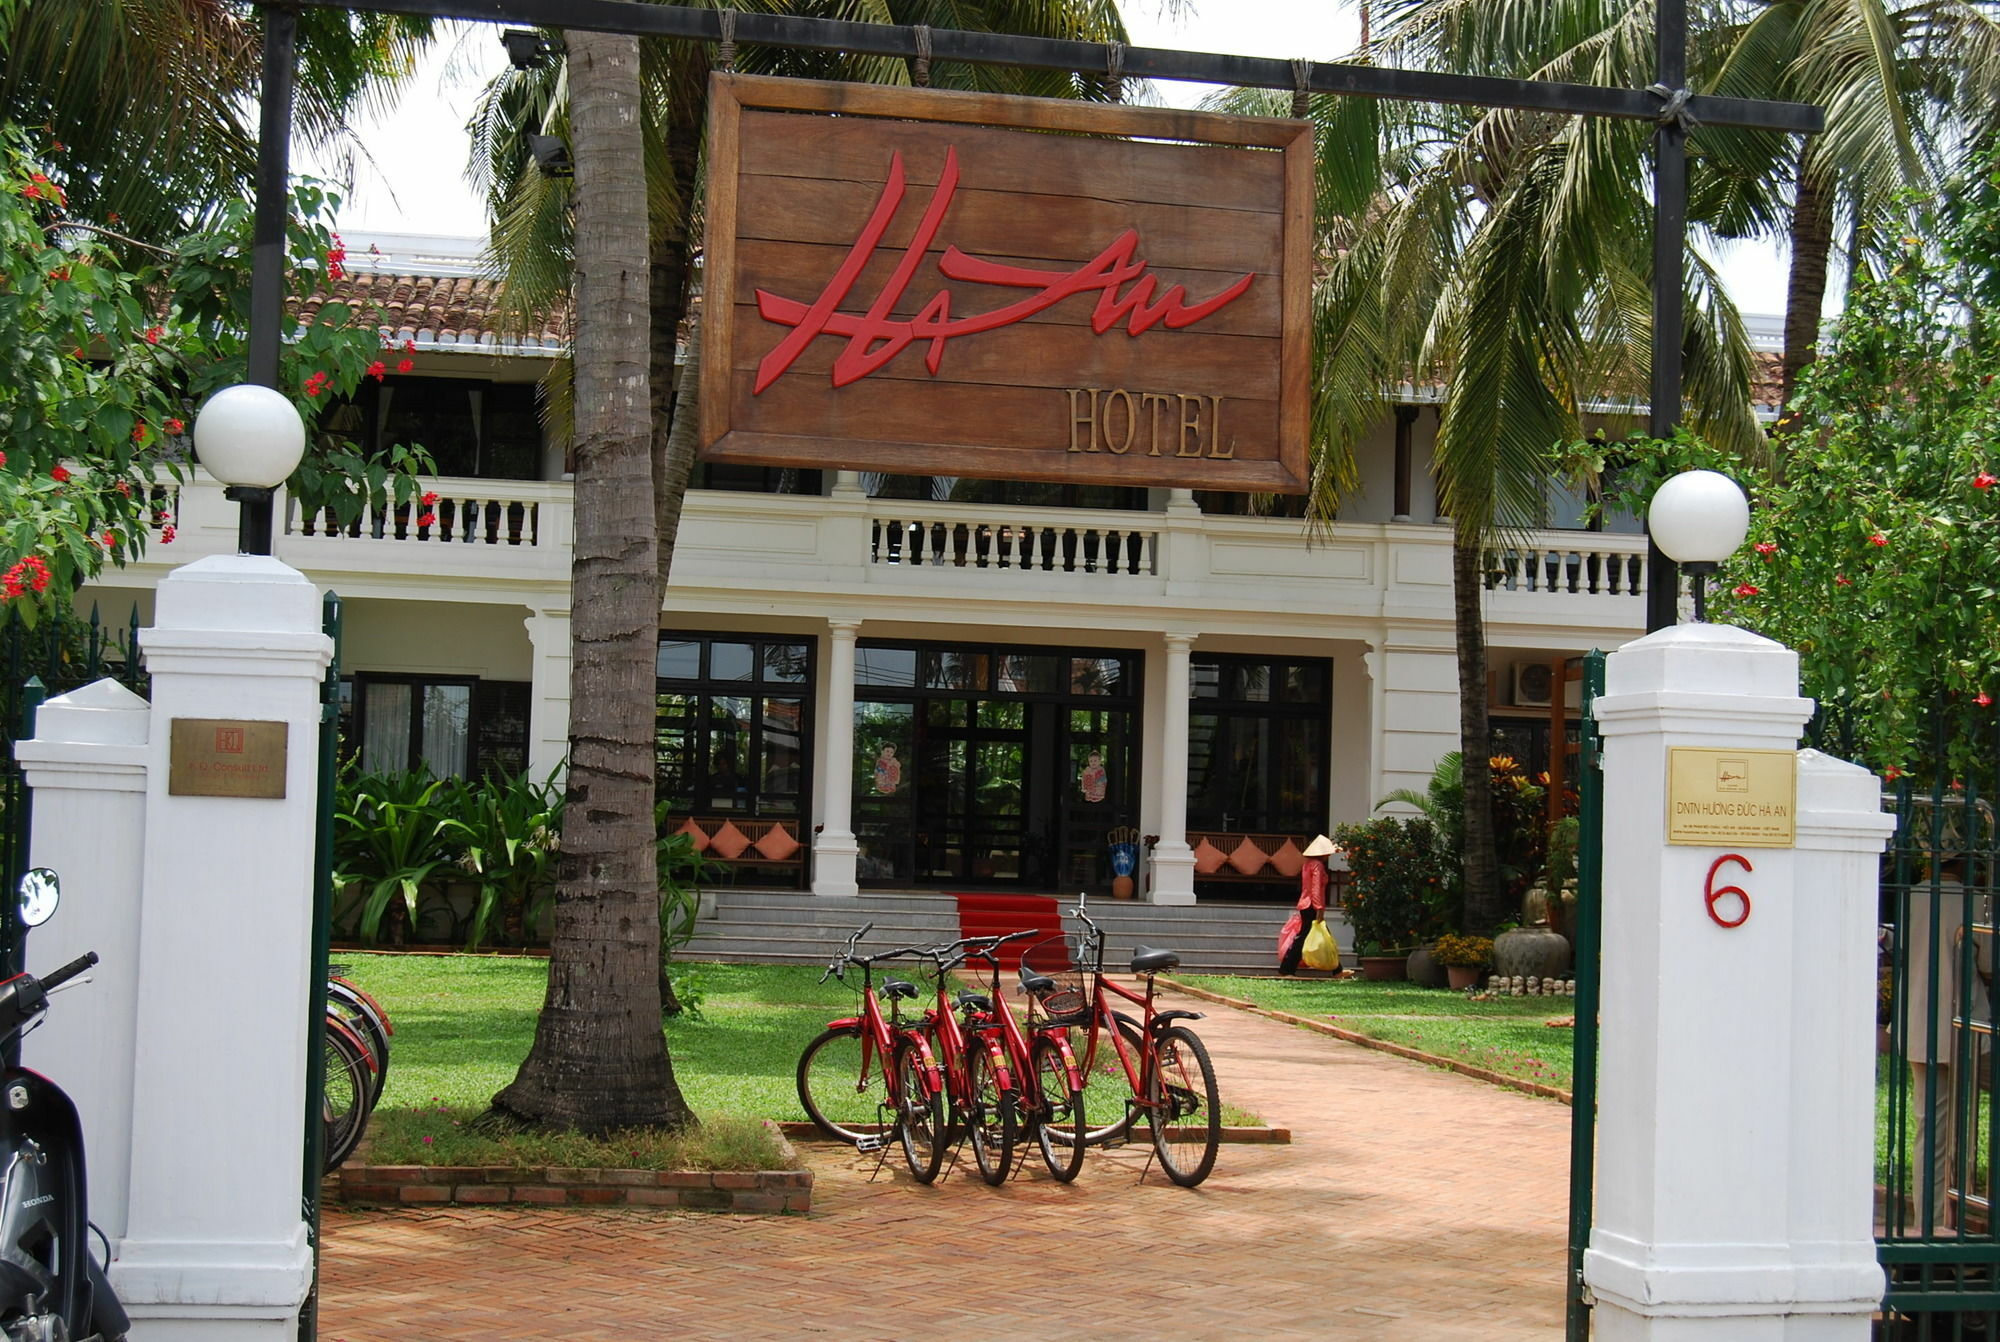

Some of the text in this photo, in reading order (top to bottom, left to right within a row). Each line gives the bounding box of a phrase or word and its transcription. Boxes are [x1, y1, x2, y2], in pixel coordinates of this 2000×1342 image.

[1066, 388, 1235, 459] HOTEL
[1677, 801, 1700, 815] DNTN
[1774, 805, 1787, 817] AN
[1704, 854, 1752, 928] 6
[22, 1194, 54, 1208] HONDA
